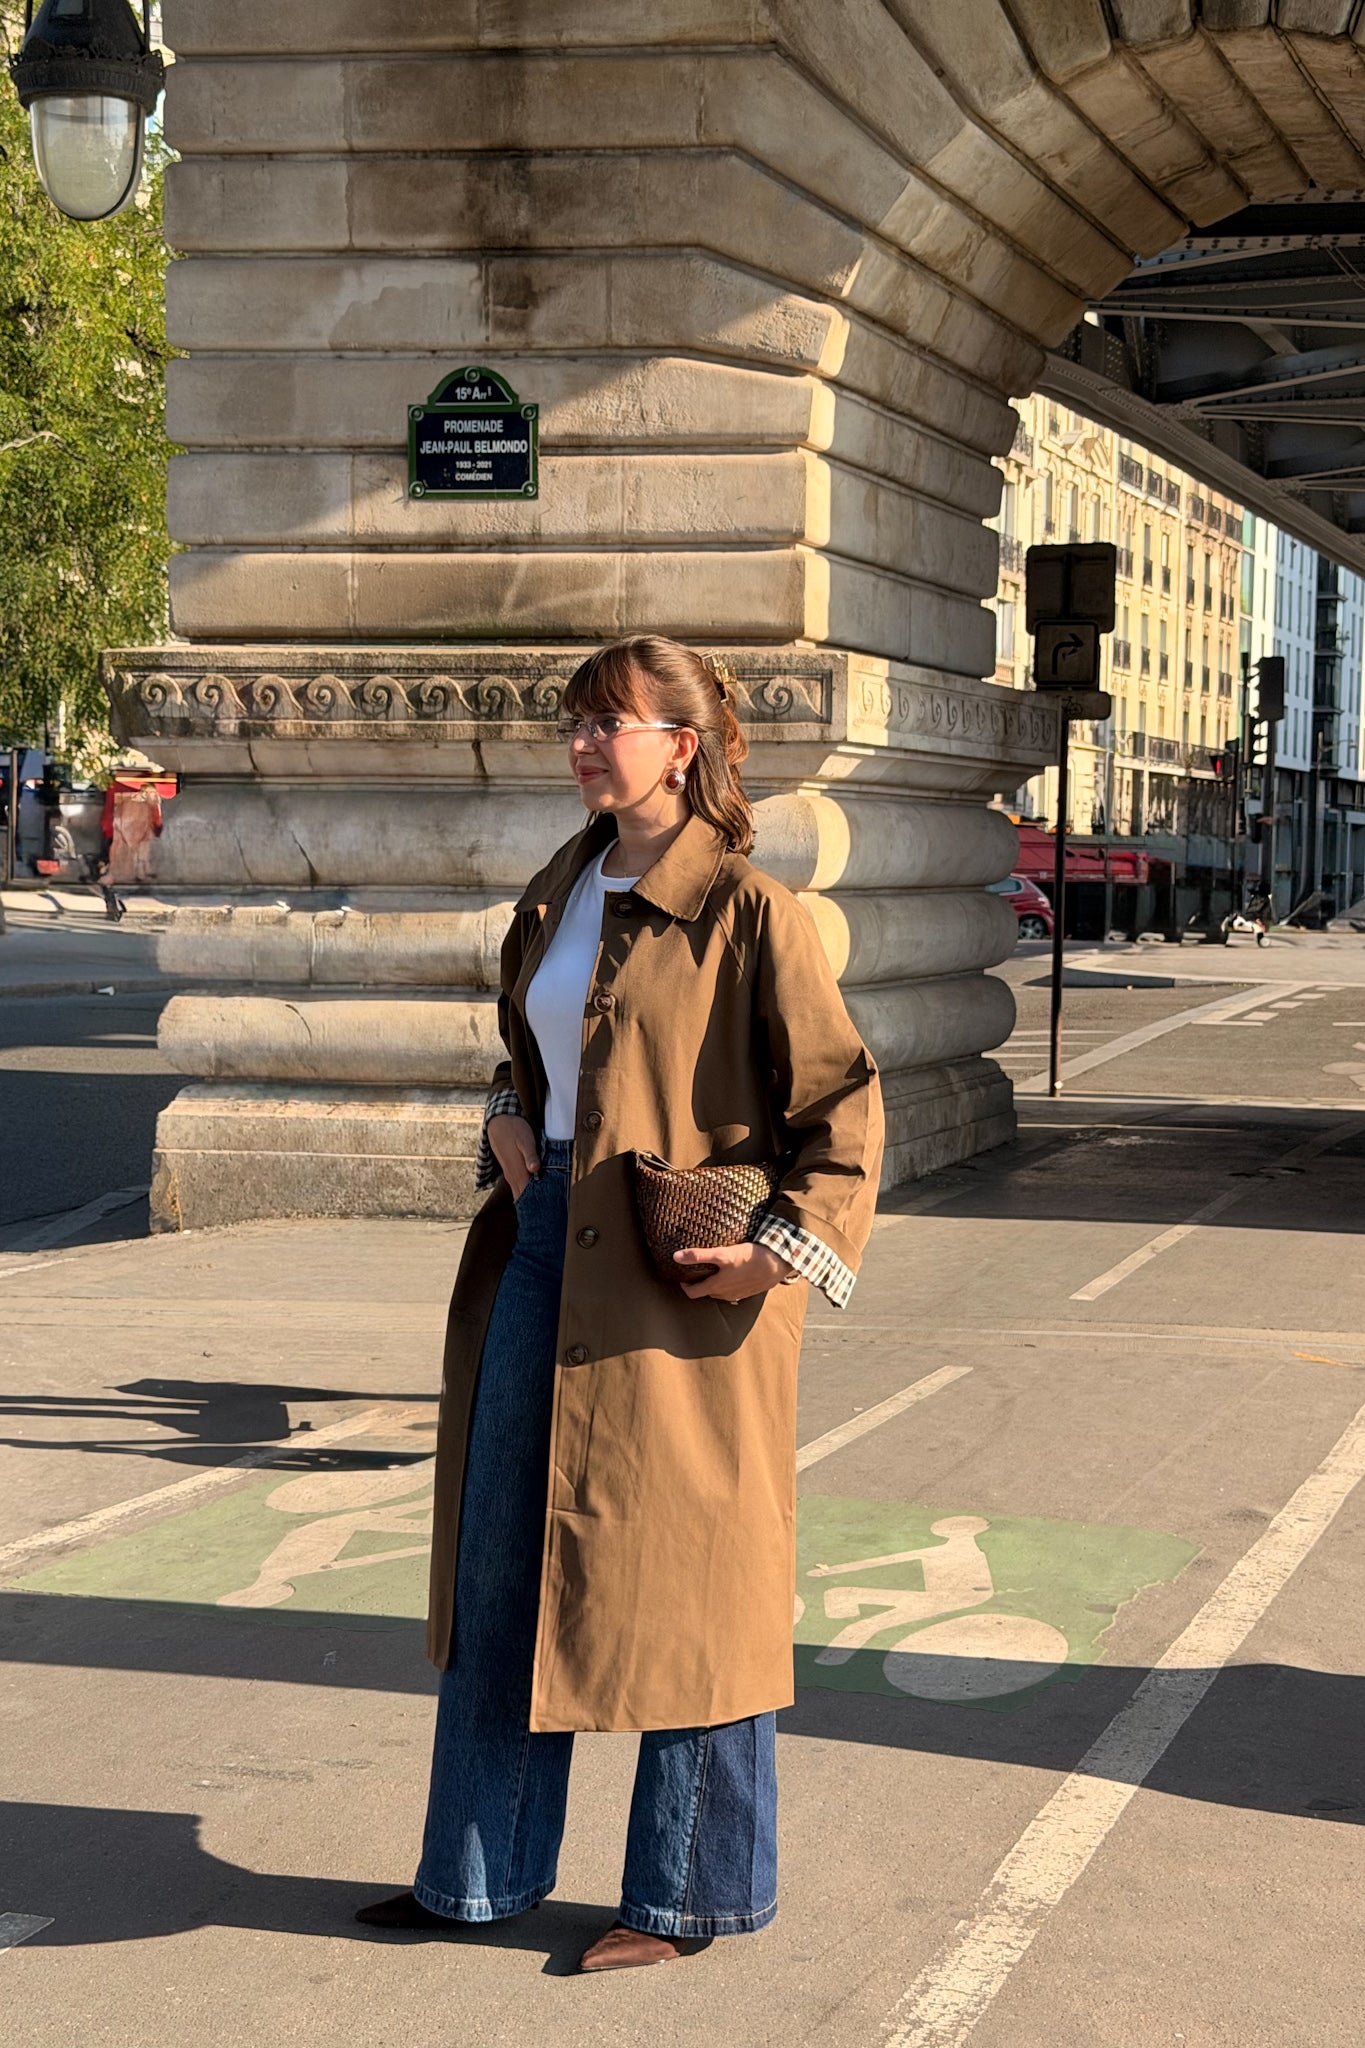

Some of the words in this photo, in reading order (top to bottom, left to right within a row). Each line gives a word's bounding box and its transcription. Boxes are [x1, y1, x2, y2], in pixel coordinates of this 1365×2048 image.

[443, 420, 504, 433] PROMENADE
[420, 440, 473, 454] JEAN-PAUL
[474, 439, 528, 454] BELMONDO
[455, 461, 472, 469] 1933
[476, 461, 492, 469] 2021
[455, 469, 493, 481] COMÉDIEN
